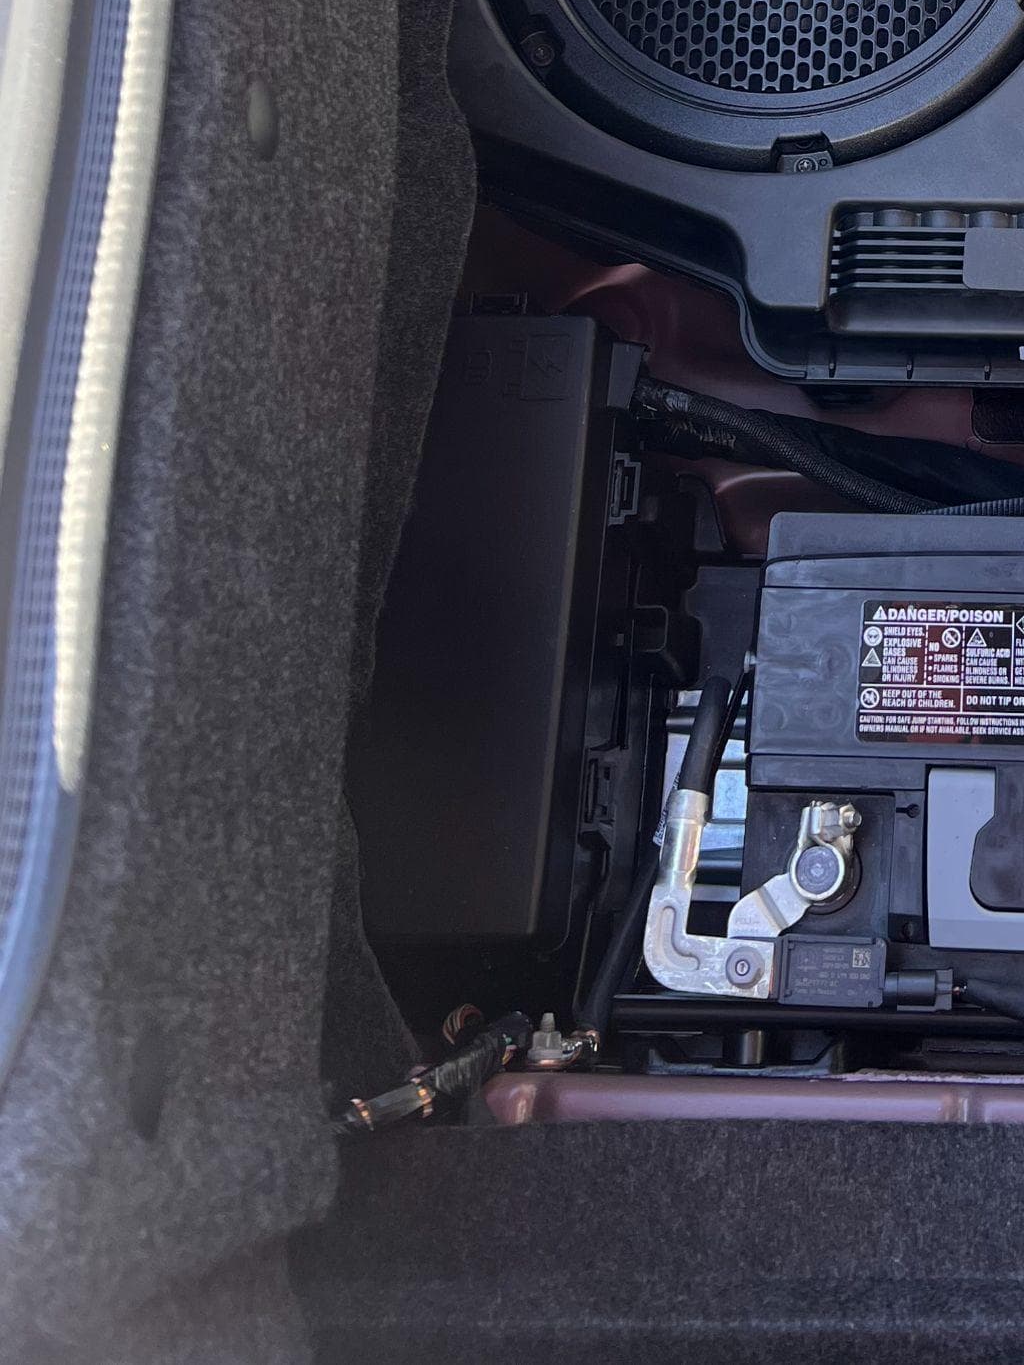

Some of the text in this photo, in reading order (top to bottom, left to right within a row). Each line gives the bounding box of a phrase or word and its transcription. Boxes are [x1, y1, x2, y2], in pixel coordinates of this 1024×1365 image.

[888, 608, 1004, 623] DANGER/POISON
[883, 638, 922, 648] EXPLOSIVE
[929, 642, 940, 652] NO
[883, 648, 906, 656] GASES
[966, 695, 978, 705] DO
[979, 695, 997, 705] NOT
[998, 696, 1011, 706] TIP
[1013, 696, 1024, 706] OR
